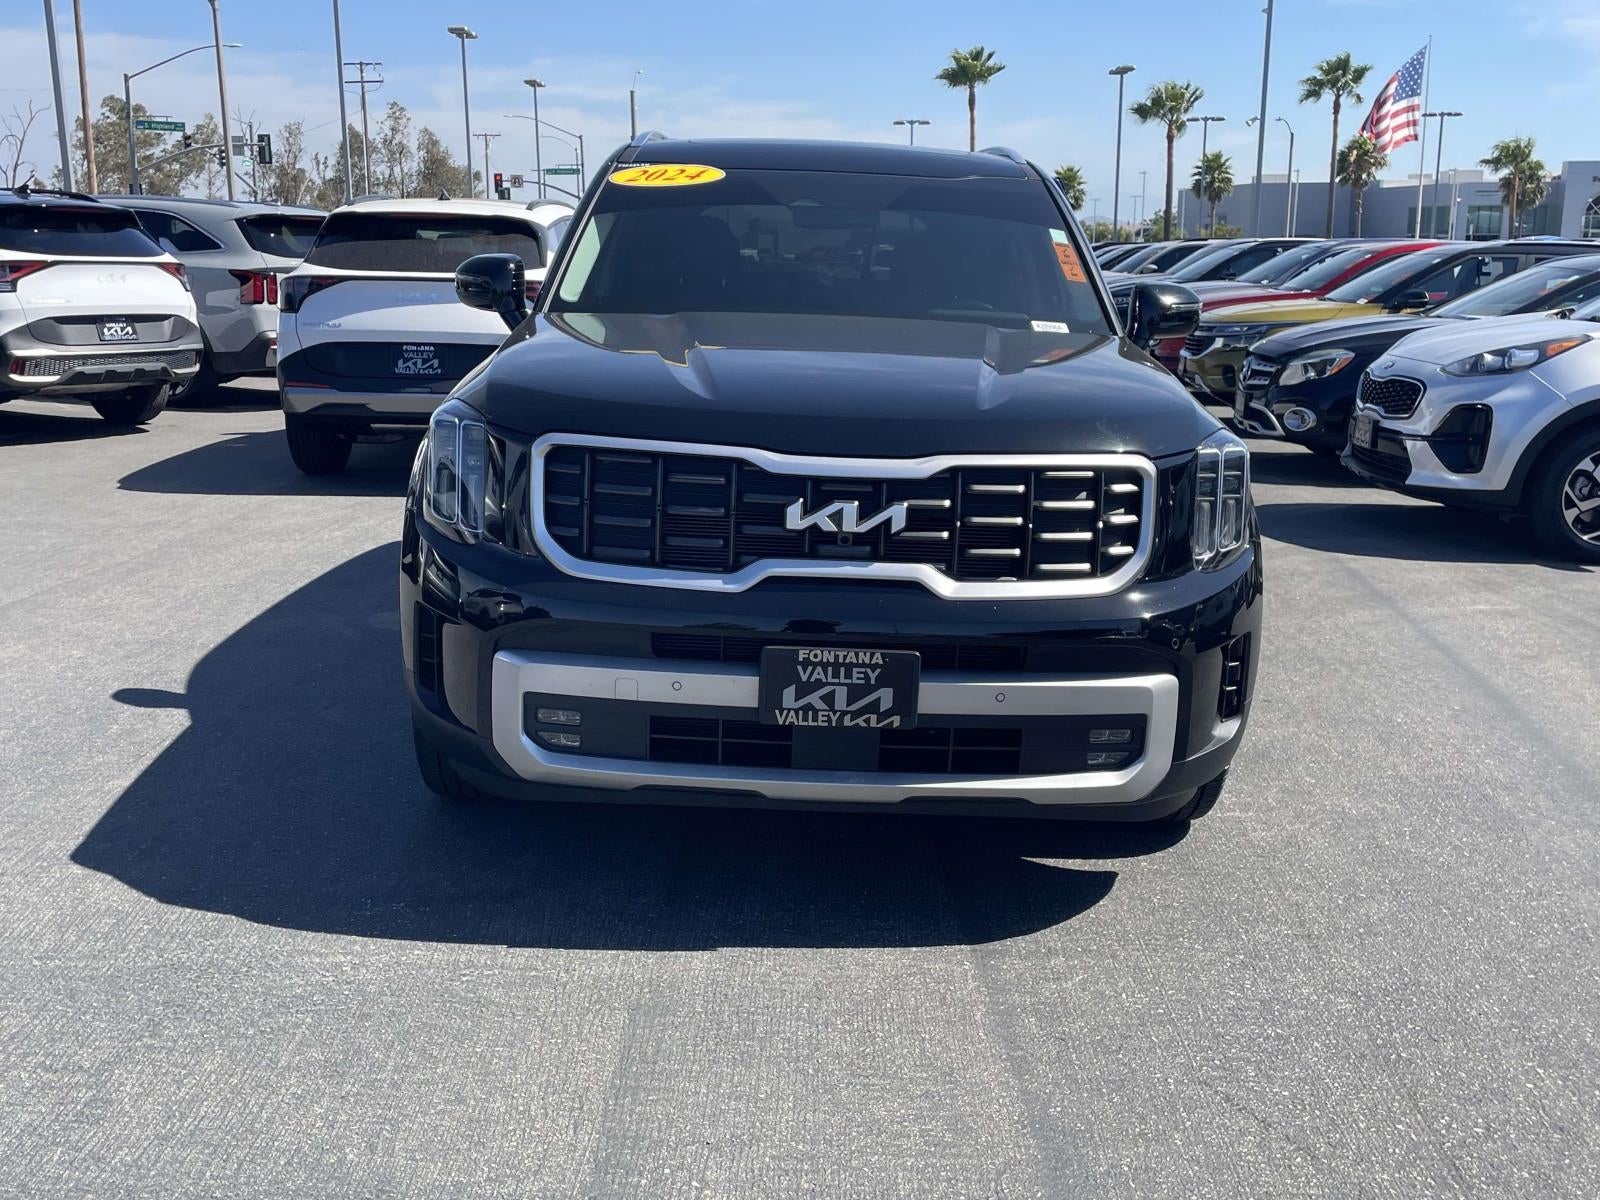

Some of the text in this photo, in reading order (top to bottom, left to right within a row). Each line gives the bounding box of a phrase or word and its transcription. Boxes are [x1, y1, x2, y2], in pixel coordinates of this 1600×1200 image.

[624, 168, 709, 182] 2024
[103, 326, 133, 336] KIA
[402, 351, 435, 359] VALLEY
[397, 358, 439, 369] KIA
[785, 498, 907, 535] KIA
[798, 650, 883, 665] FONTANA
[797, 665, 881, 685] VALLEY
[782, 684, 893, 713] KIA
[775, 709, 900, 729] VALLEY KIA
